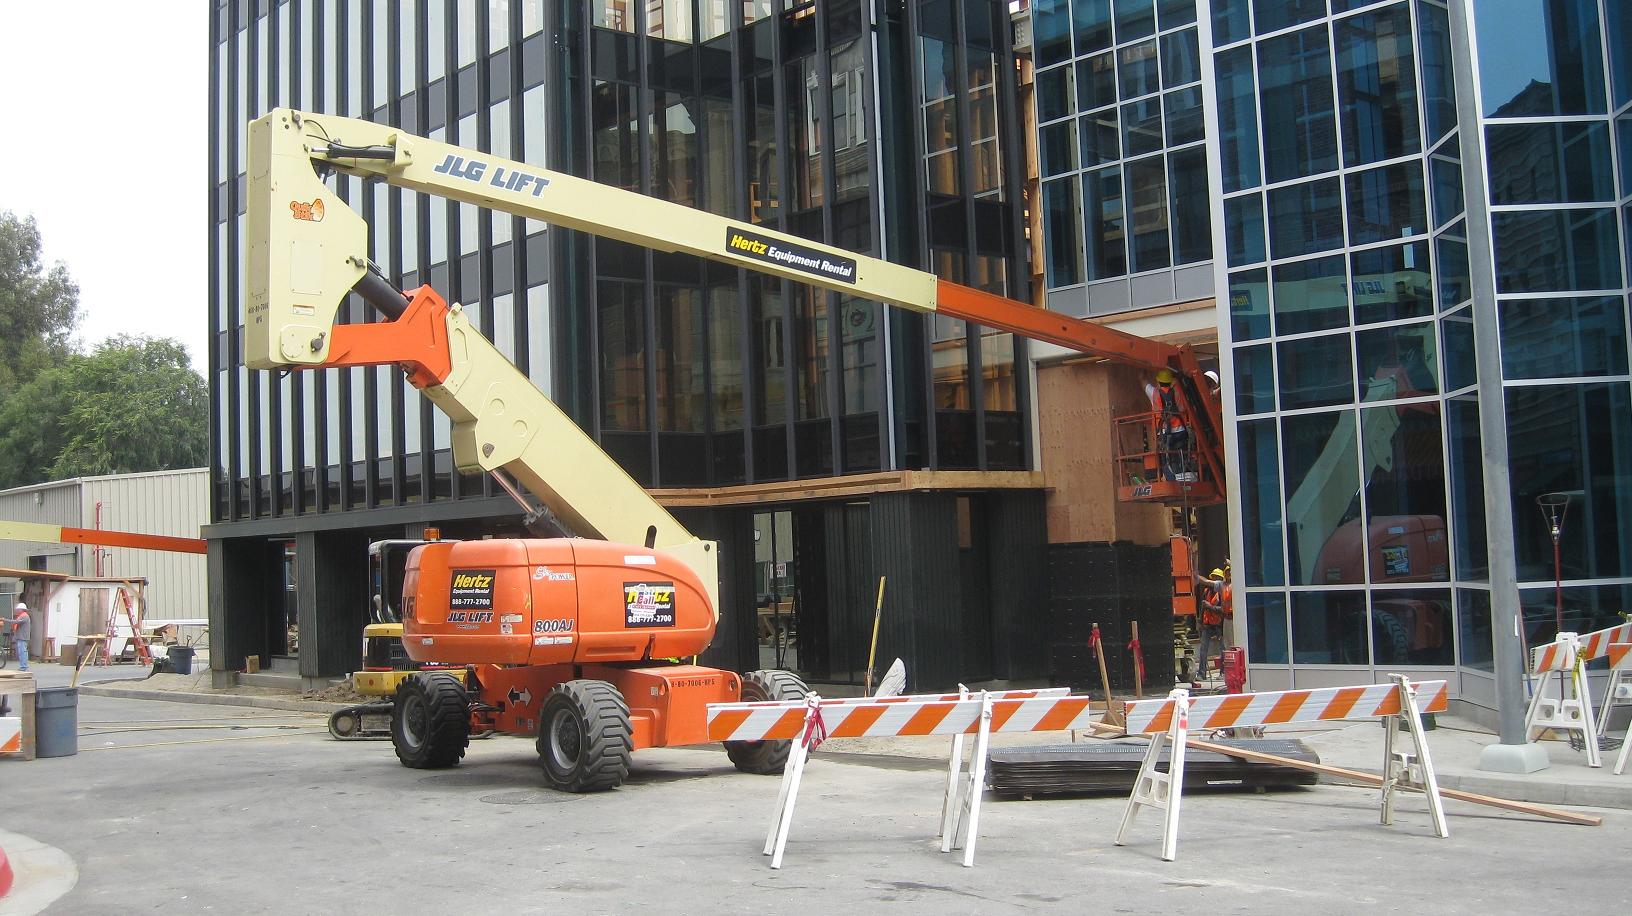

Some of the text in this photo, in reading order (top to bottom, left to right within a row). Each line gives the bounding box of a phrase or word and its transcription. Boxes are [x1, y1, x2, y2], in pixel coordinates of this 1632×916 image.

[433, 153, 551, 198] JLG LIFT
[730, 234, 853, 277] Hertz Equipment Rental
[1131, 484, 1153, 497] JLG
[453, 574, 493, 588] Hertz
[447, 611, 467, 623] JLG
[467, 611, 495, 623] LIFT
[534, 618, 575, 633] 800AJ
